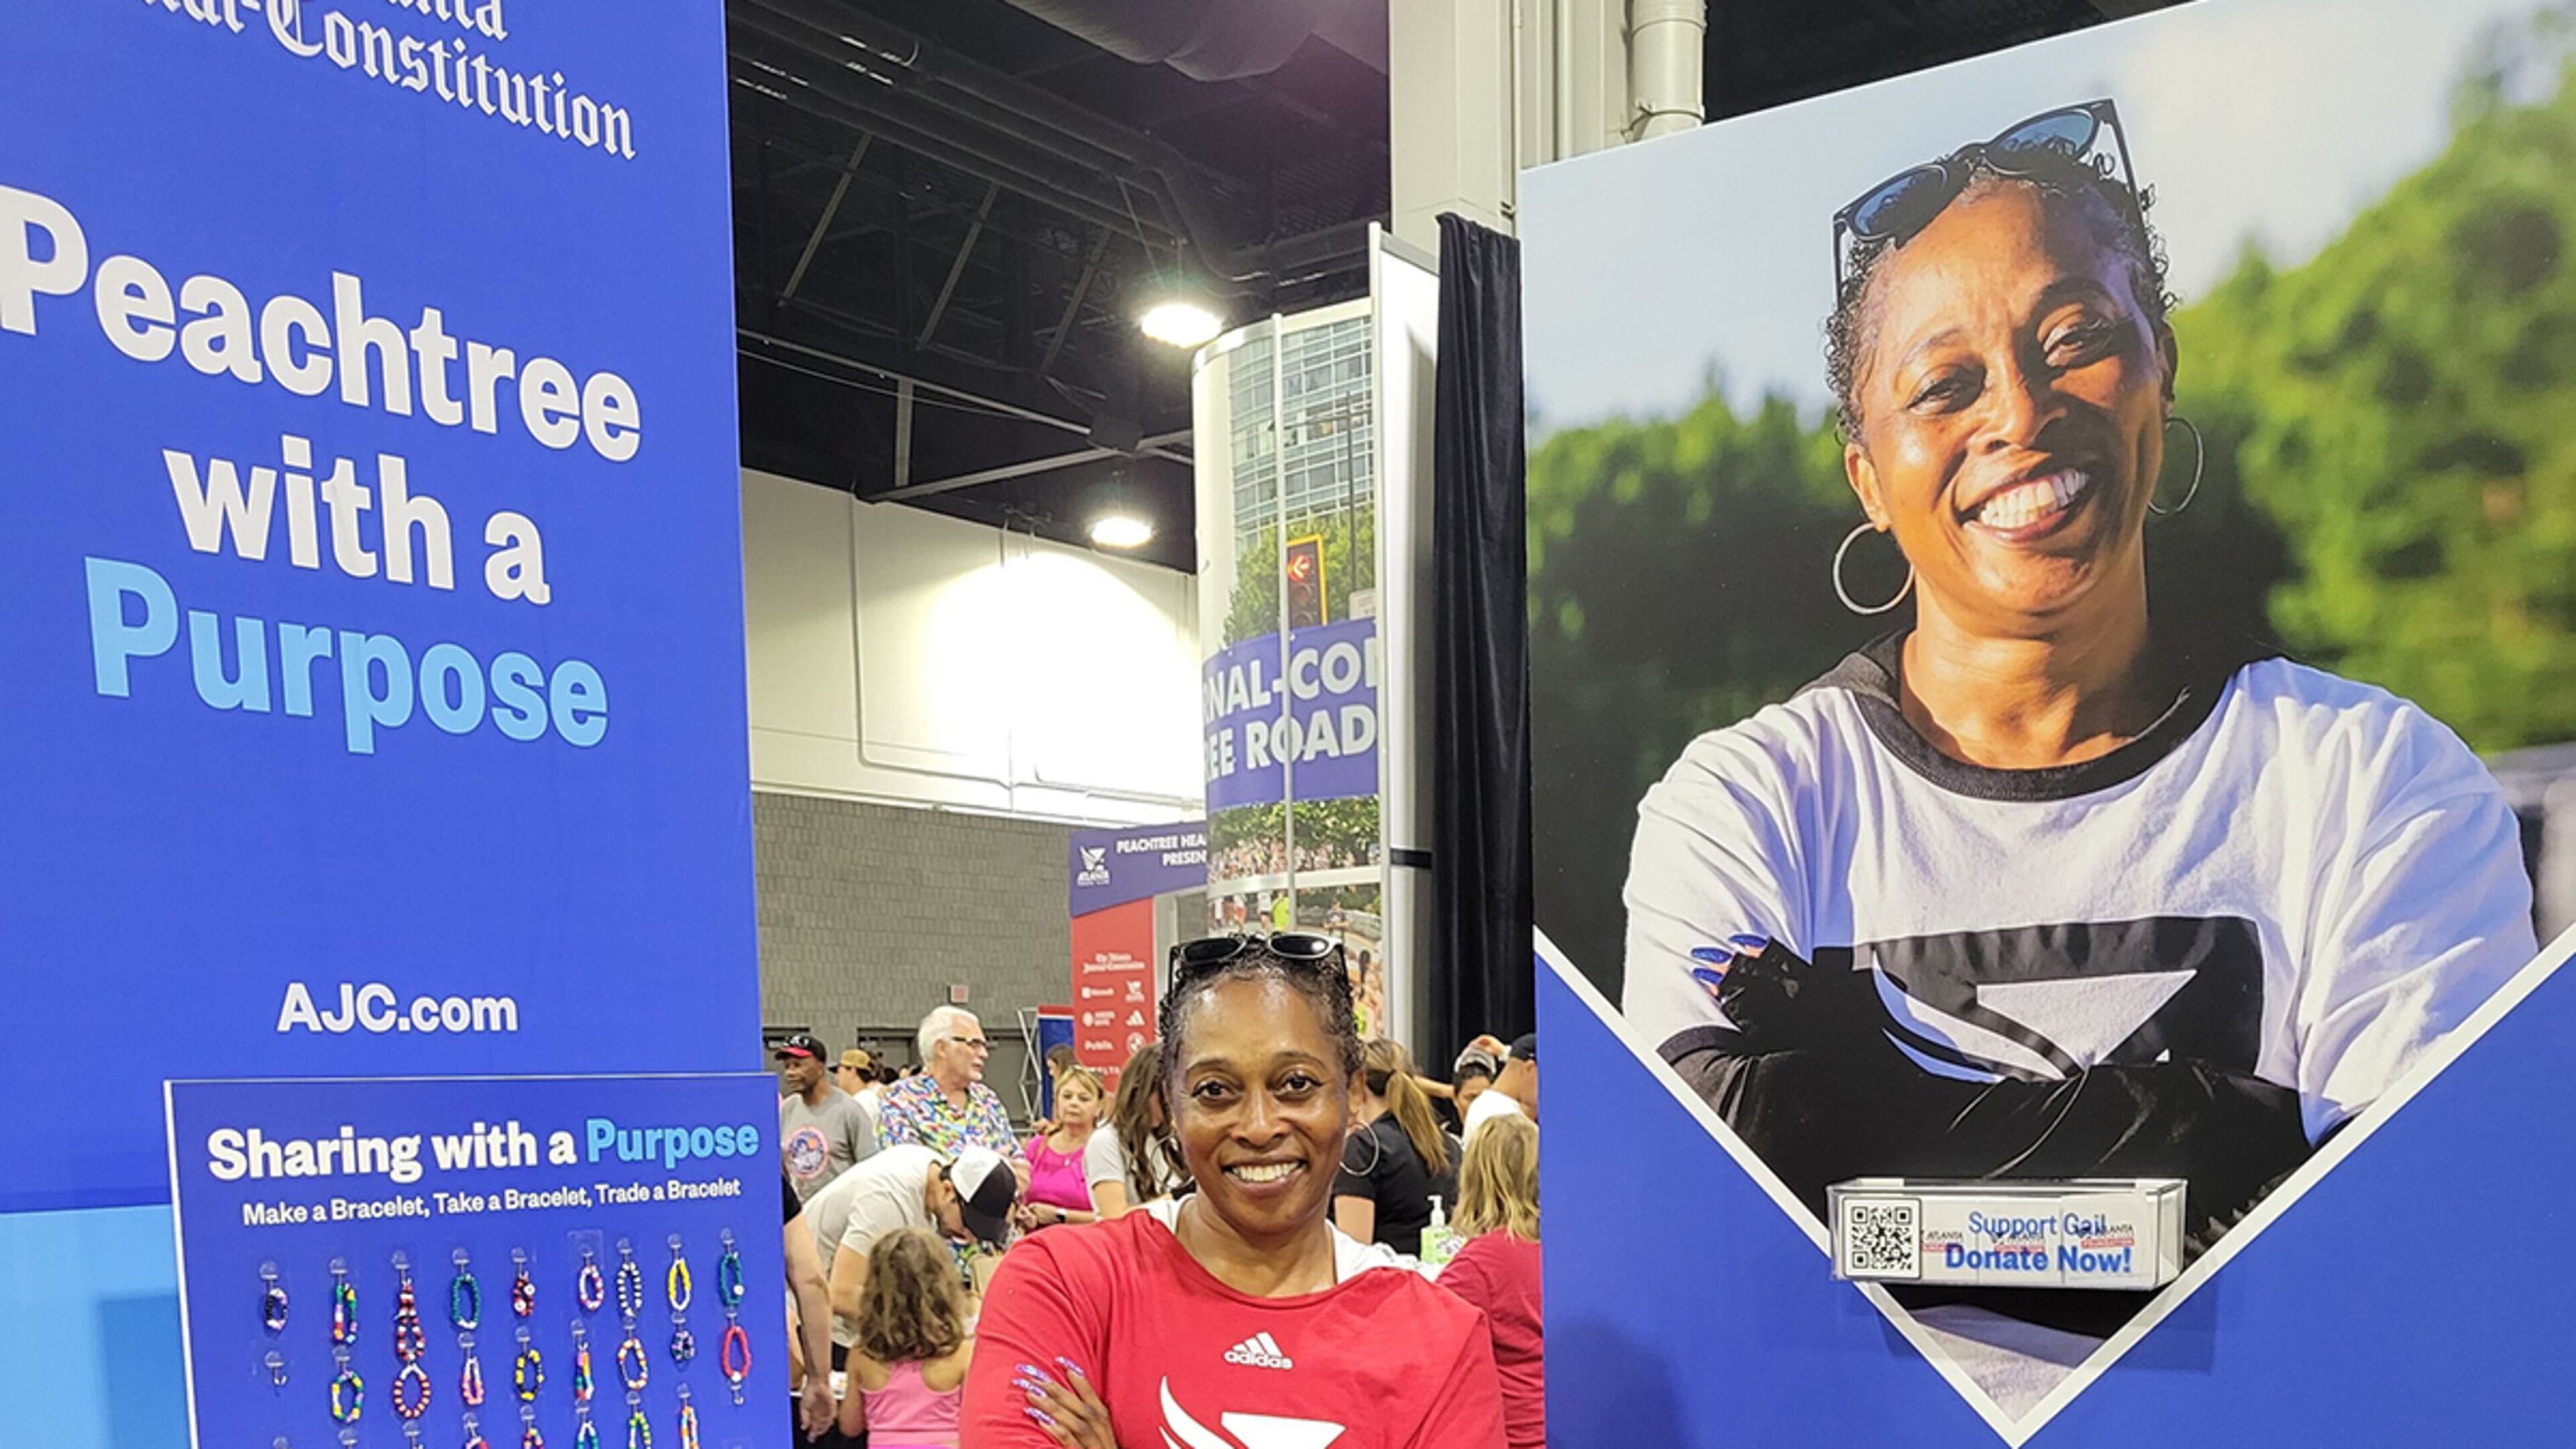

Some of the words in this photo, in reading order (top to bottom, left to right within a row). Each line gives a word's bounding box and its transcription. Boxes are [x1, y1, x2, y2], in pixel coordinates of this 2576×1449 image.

[0, 184, 641, 462] Peachtree
[162, 434, 454, 590] with
[484, 511, 551, 605] a
[85, 556, 609, 755] Purpose
[1203, 637, 1377, 724] NAL-CO
[1205, 728, 1236, 784] EE
[1246, 704, 1377, 769] ROAD
[1116, 836, 1179, 853] PEACHTREE
[276, 982, 518, 1032] AJC.com
[207, 1125, 423, 1183] Sharing
[431, 1120, 537, 1169] with
[548, 1130, 578, 1165] a
[585, 1118, 759, 1168] Purpose
[243, 1202, 308, 1226] Make
[313, 1206, 327, 1222] a
[331, 1197, 431, 1221] Bracelet,
[433, 1192, 484, 1214] Take
[488, 1197, 502, 1212] a
[505, 1187, 592, 1210] Bracelet,
[594, 1183, 650, 1205] Trade
[653, 1189, 665, 1201] a
[668, 1178, 741, 1199] Bracelet
[1968, 1212, 2057, 1238] Support
[2063, 1213, 2106, 1236] Gail
[1945, 1244, 2049, 1270] Donate
[2058, 1245, 2132, 1273] Now!
[1224, 1350, 1293, 1370] adidas
